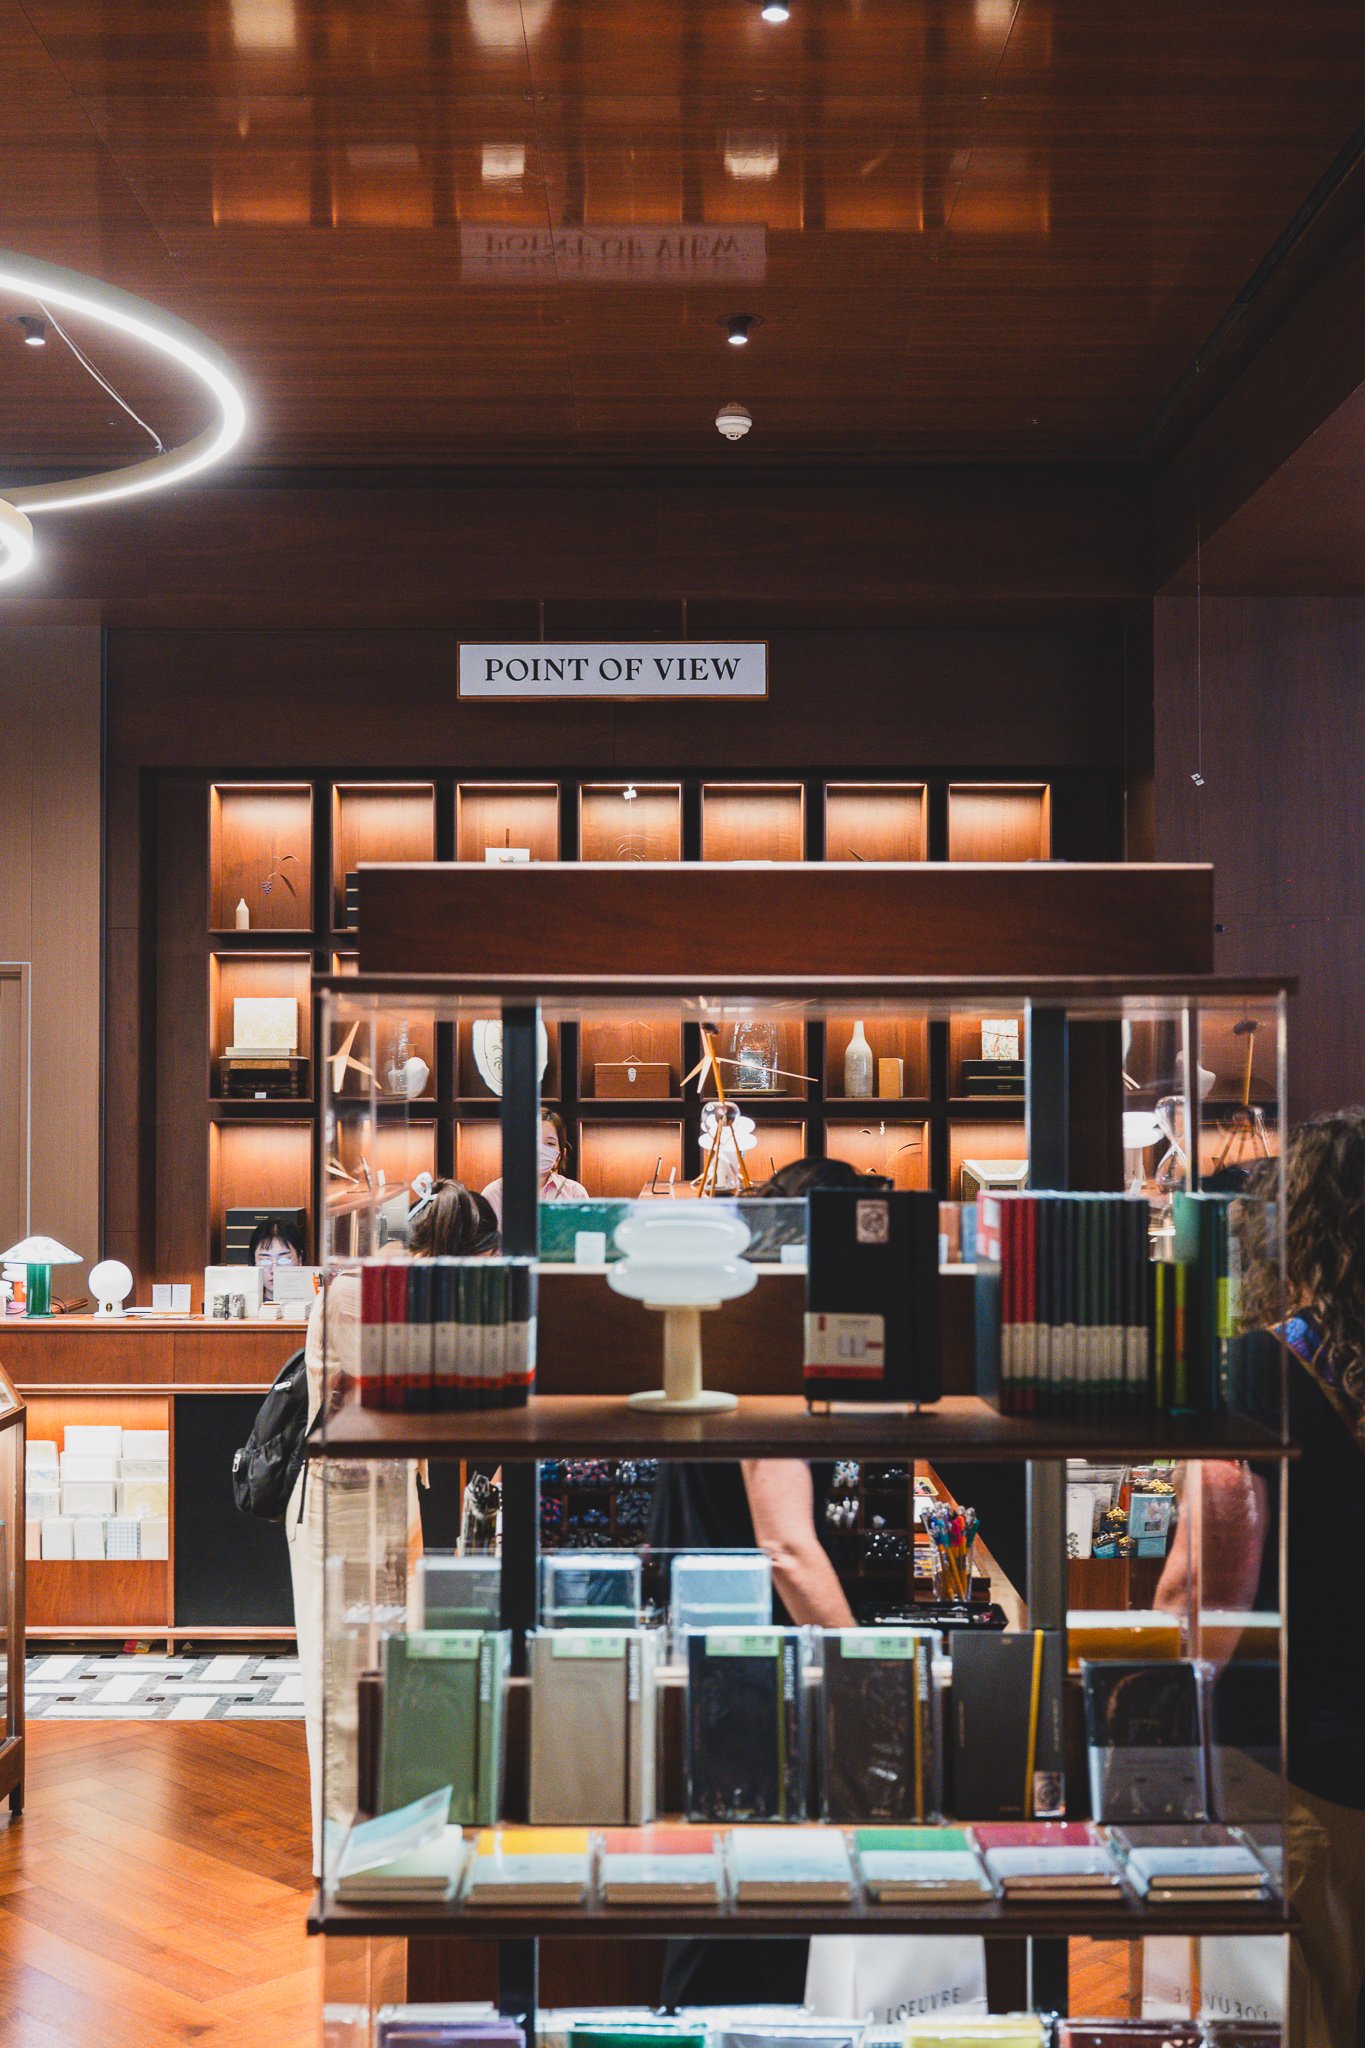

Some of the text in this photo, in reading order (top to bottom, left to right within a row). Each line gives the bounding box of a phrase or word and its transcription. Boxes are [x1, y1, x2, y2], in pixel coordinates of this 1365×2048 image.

[484, 658, 741, 681] POINT OF VIEW
